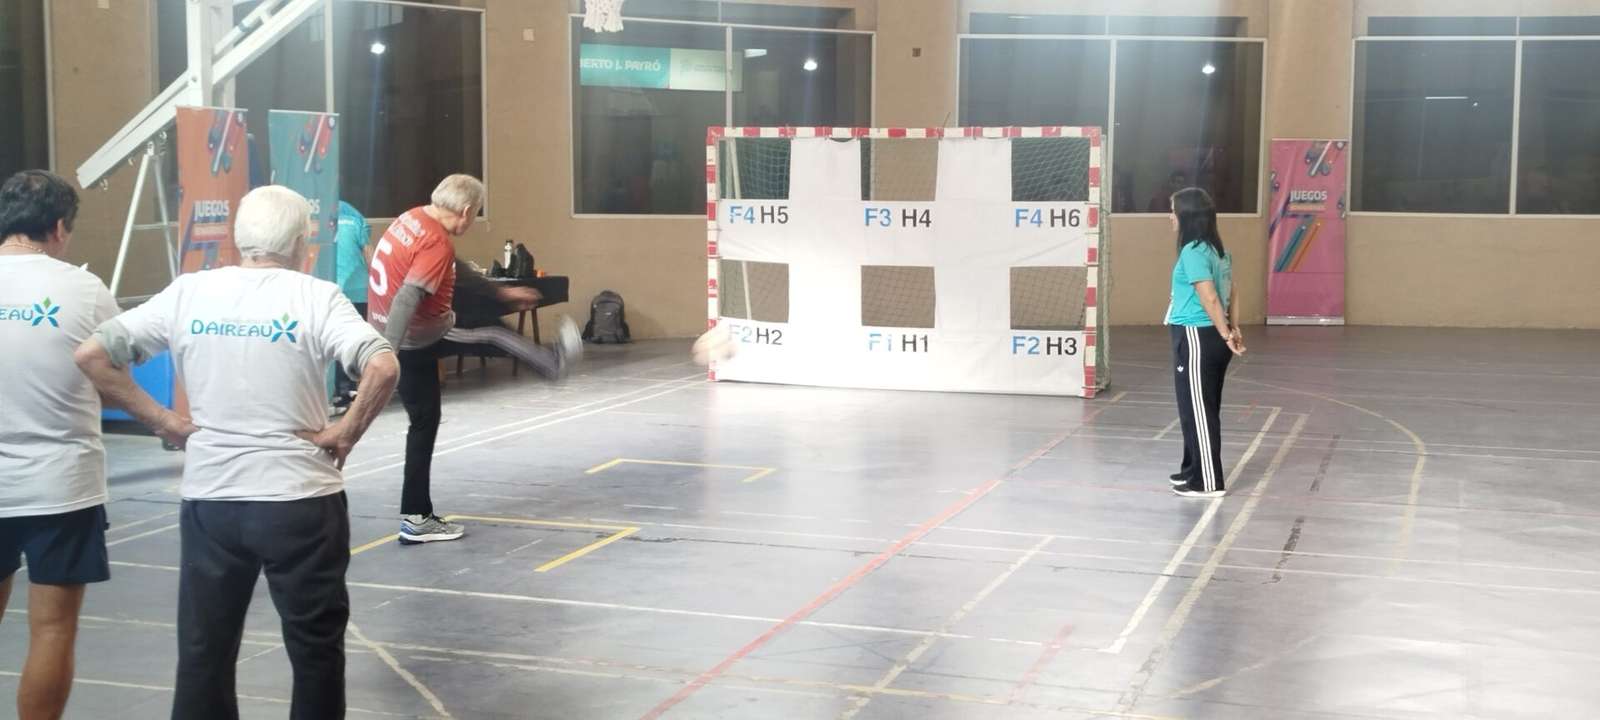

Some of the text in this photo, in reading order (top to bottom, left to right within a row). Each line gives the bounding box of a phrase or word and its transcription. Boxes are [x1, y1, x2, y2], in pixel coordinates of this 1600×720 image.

[1290, 190, 1328, 202] JUEGOS
[194, 200, 230, 221] JUEGOS
[729, 206, 789, 225] F4 H5
[864, 208, 932, 228] F3 H4
[1015, 208, 1081, 228] F4 H6
[369, 237, 393, 297] 5
[728, 324, 783, 346] F2 H2
[902, 333, 929, 353] H1
[1012, 335, 1078, 356] F2 H3
